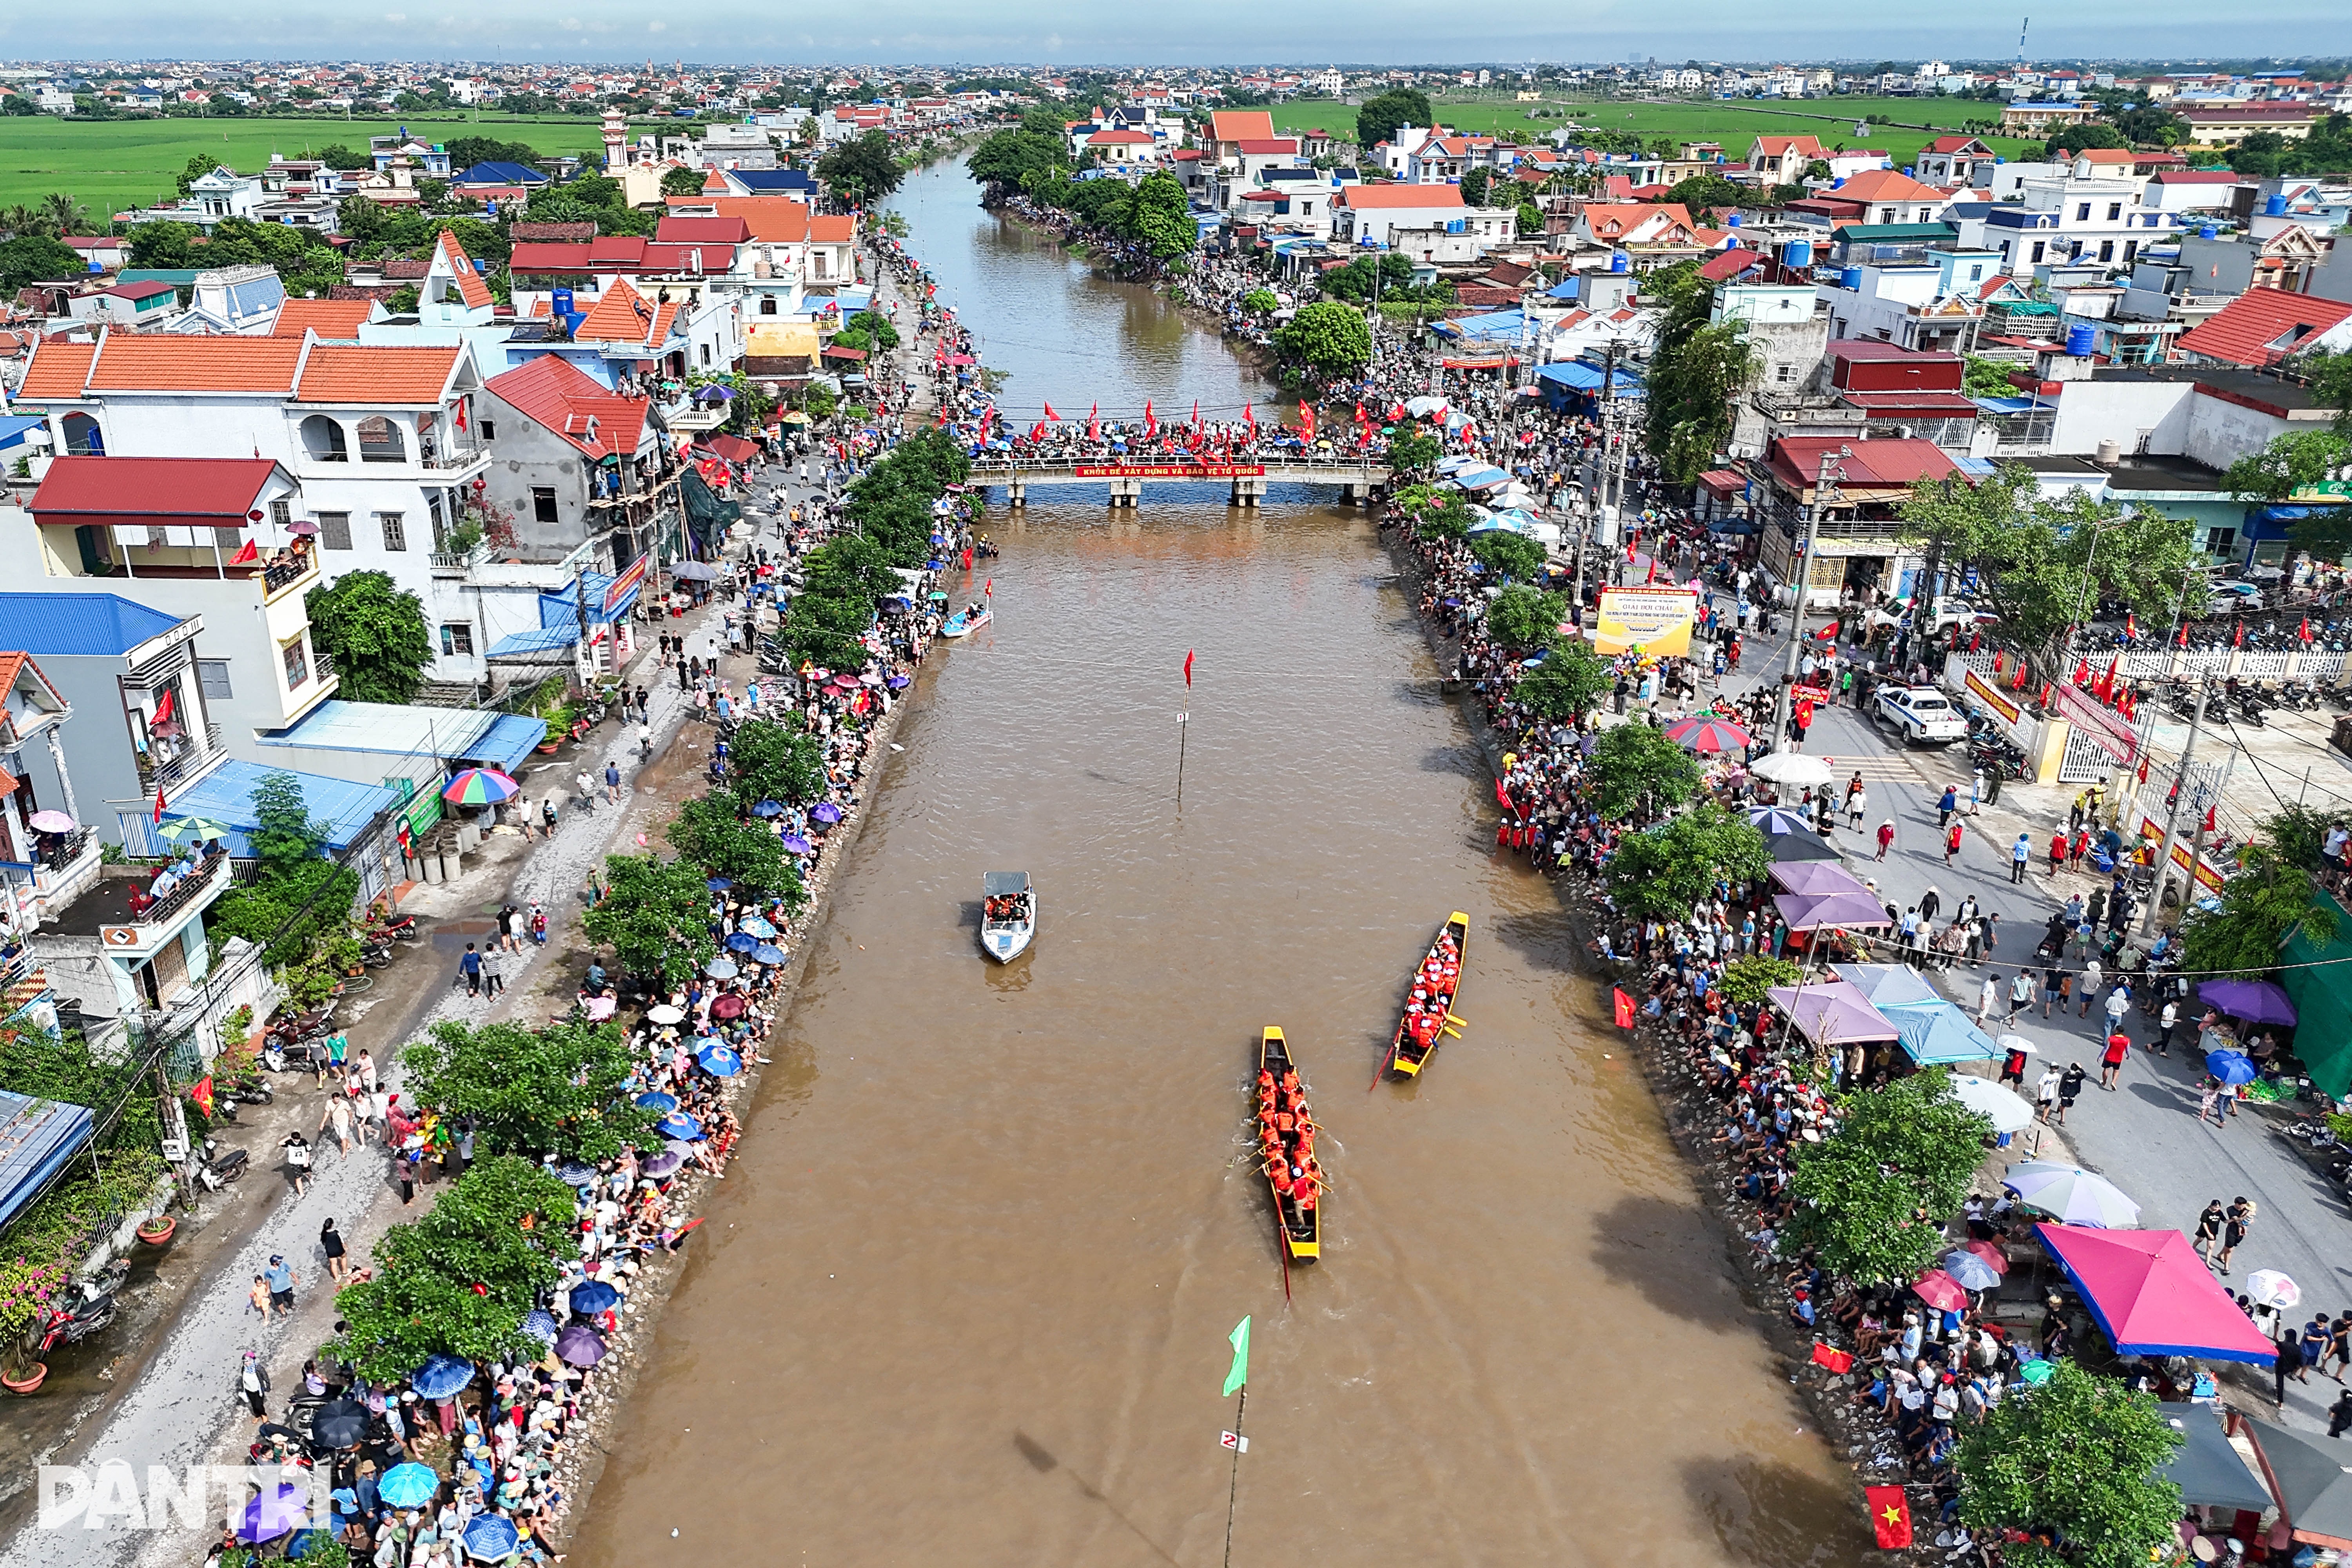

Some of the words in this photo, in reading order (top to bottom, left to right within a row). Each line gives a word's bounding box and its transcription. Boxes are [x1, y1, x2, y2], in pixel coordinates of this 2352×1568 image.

[2138, 324, 2165, 332] 1997
[1207, 467, 1218, 475] VỆ
[1221, 466, 1232, 474] TỔ
[1235, 466, 1258, 475] QUỐC
[1223, 1434, 1236, 1447] 2
